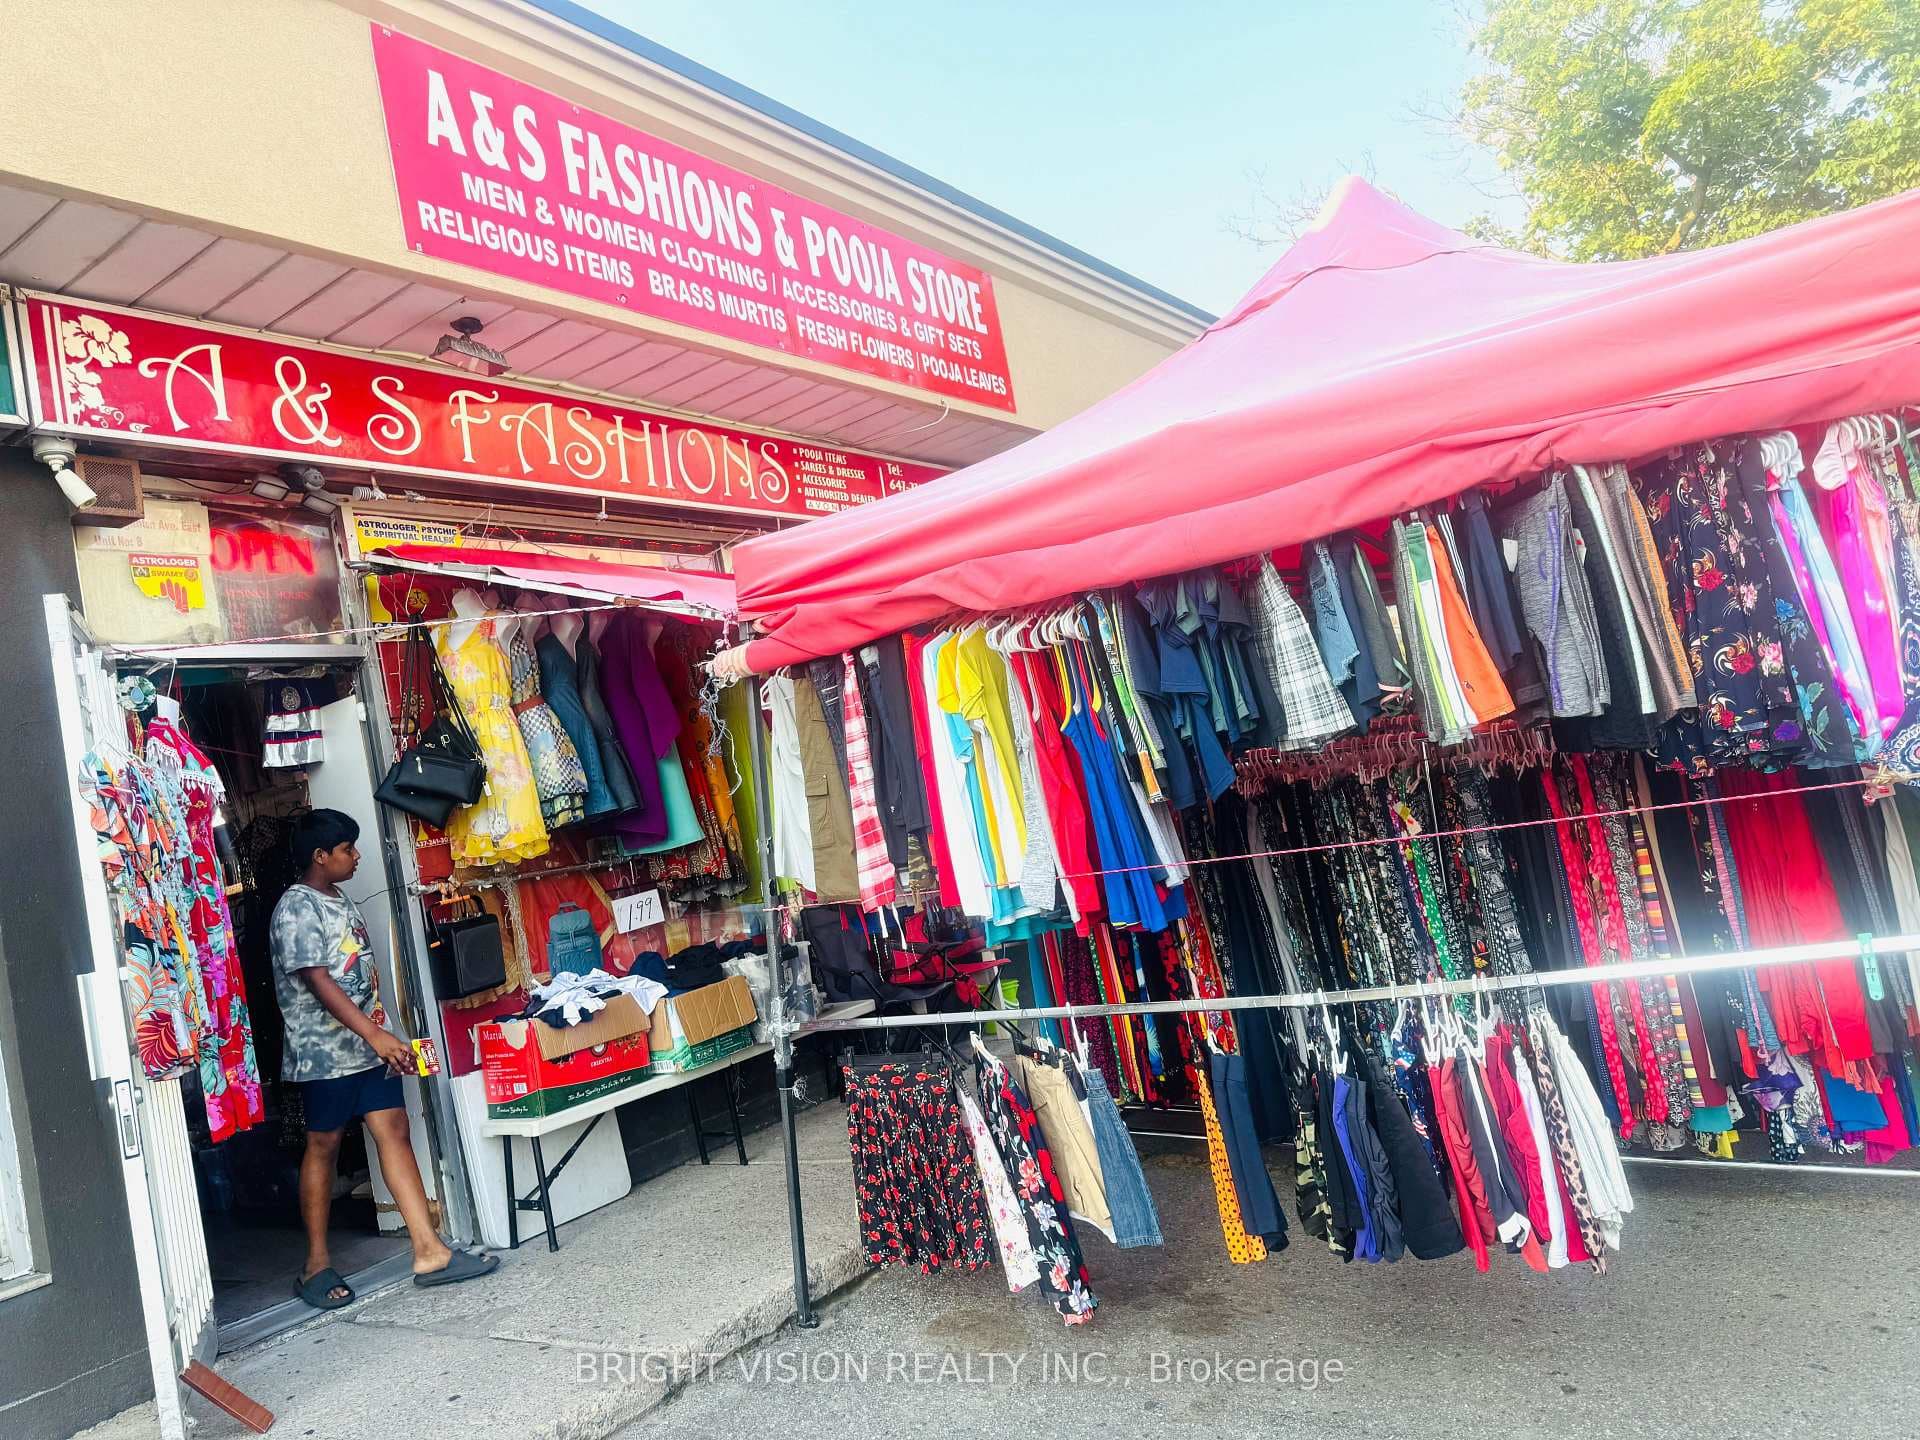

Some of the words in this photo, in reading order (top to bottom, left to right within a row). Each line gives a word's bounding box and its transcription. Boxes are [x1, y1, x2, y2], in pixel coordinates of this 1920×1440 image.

[557, 119, 762, 257] FASHIONS
[770, 207, 800, 270] &
[801, 216, 904, 307] POOJA
[906, 257, 988, 335] STORE
[461, 171, 527, 218] MEN
[535, 196, 555, 225] &
[558, 203, 657, 257] WOMEN
[661, 237, 768, 292] CLOTHING
[782, 276, 898, 333] ACCESSORIES
[900, 315, 912, 337] &
[913, 321, 945, 348] GIFT
[947, 333, 982, 359] SETS
[417, 200, 560, 267] RELIGIOUS
[563, 244, 635, 288] ITEMS
[648, 269, 716, 312] BRASS
[718, 291, 788, 333] MURTIS
[796, 315, 849, 351] FRESH
[849, 331, 915, 370] FLOWERS
[921, 353, 964, 384] POOJA
[963, 364, 1007, 395] LEAVES
[138, 344, 232, 432] A
[271, 355, 343, 448] &
[366, 375, 422, 455] S
[448, 390, 790, 504] FASHIONS
[799, 448, 823, 461] POOJA
[825, 452, 847, 465] ITEMS
[800, 461, 827, 474] SAREES
[828, 465, 835, 476] &
[836, 467, 866, 480] DRESSES
[802, 474, 847, 489] ACCESSORIES
[804, 487, 849, 502] AUTHORIZED
[373, 530, 419, 541] SPIRITUAL
[421, 525, 457, 536] PSYCHIC
[132, 556, 196, 567] ASTROLOGER
